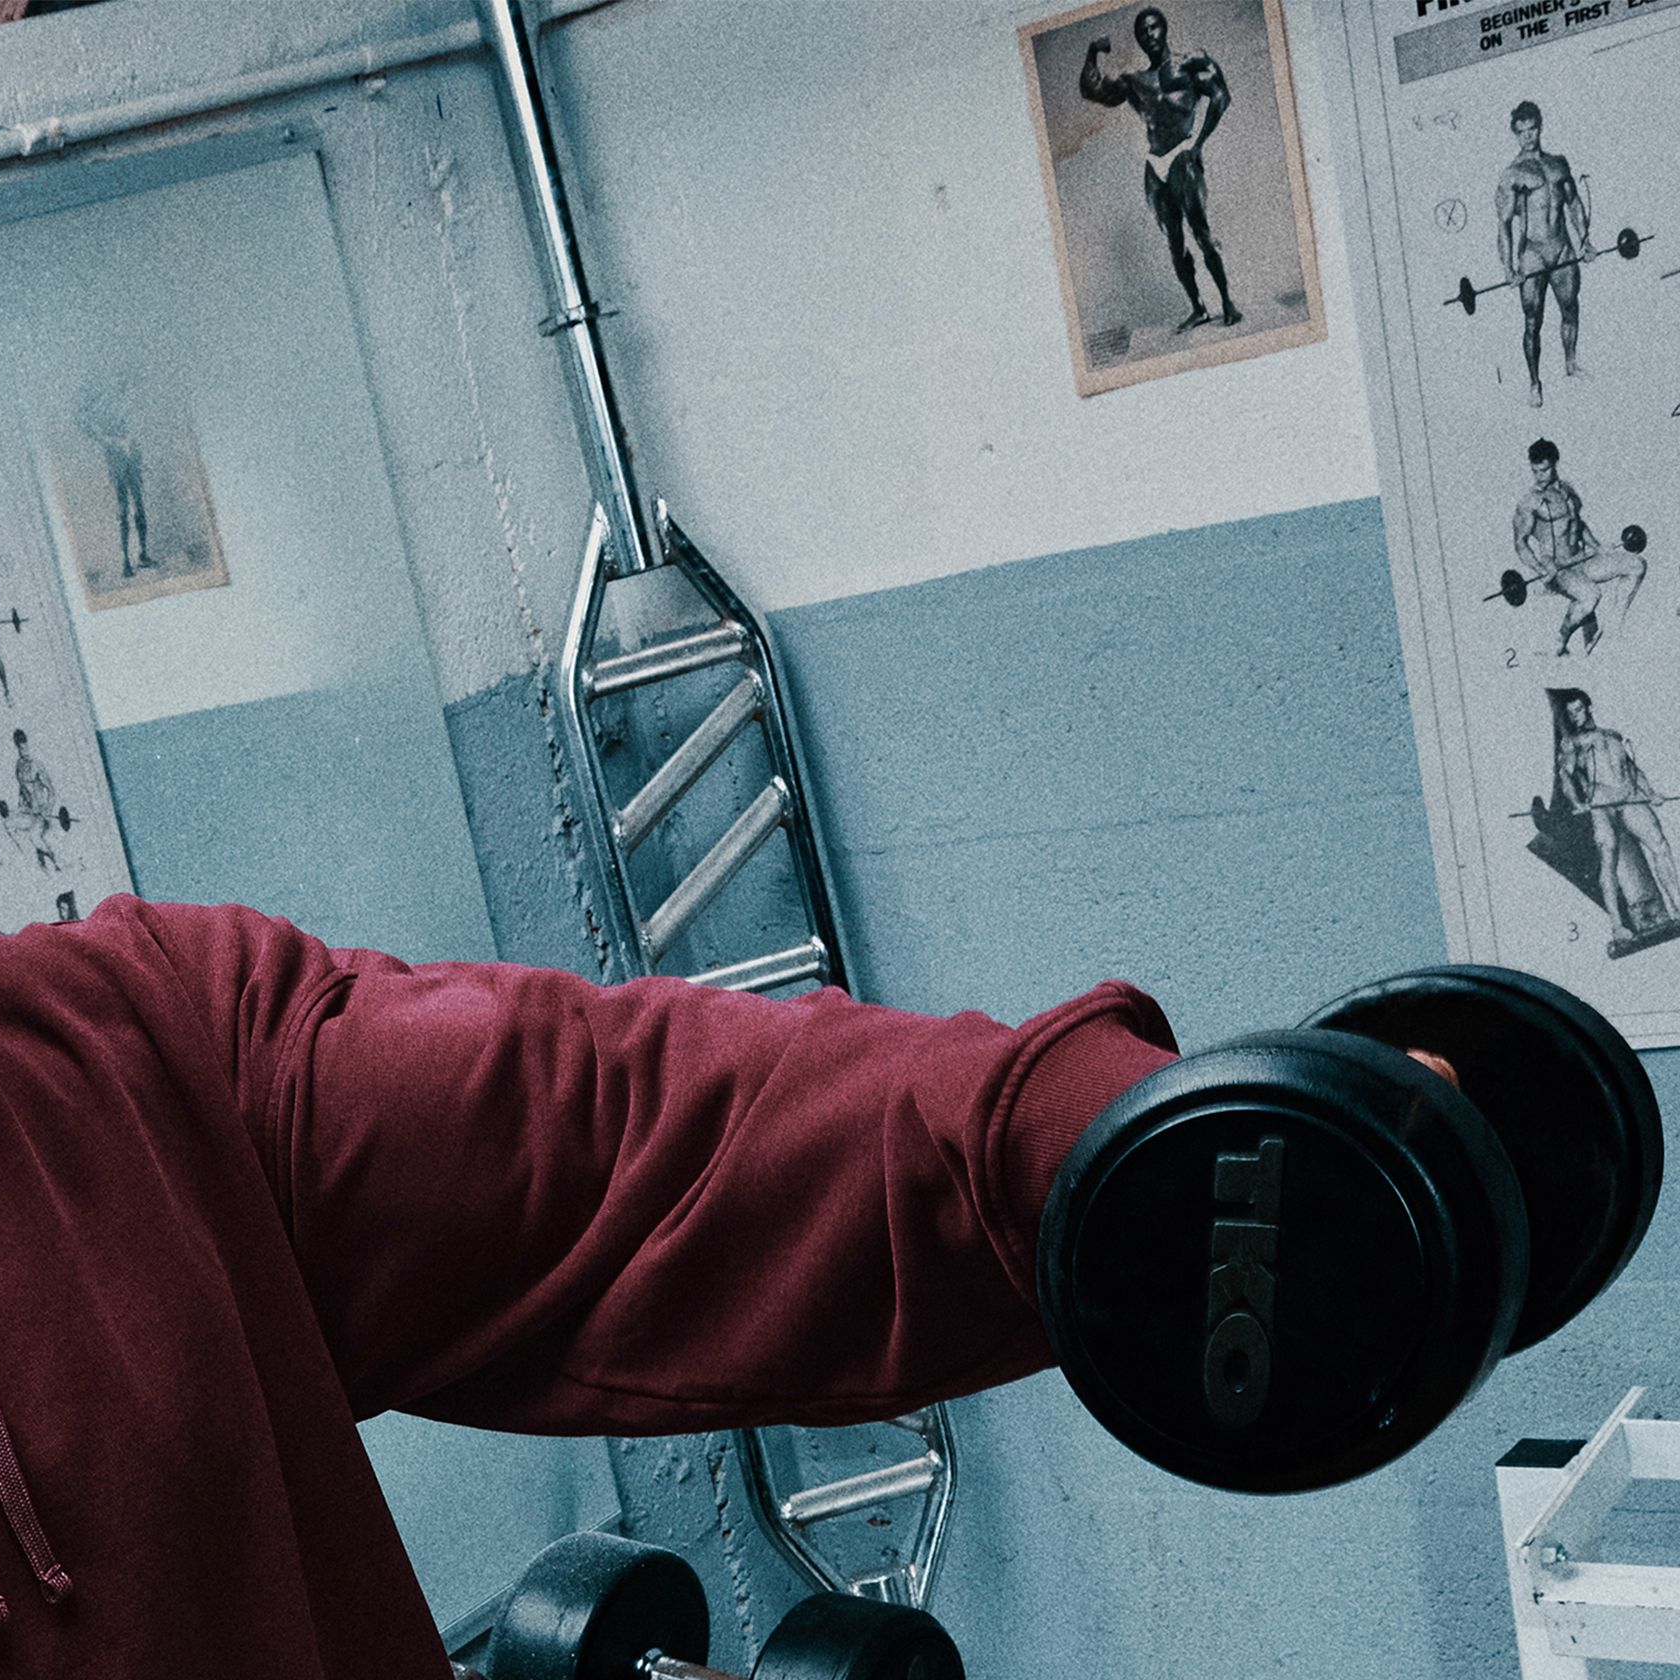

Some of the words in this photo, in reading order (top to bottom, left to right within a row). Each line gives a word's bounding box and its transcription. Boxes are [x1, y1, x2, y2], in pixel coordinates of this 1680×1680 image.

[1479, 32, 1503, 51] ON
[1516, 18, 1551, 40] THE
[1564, 0, 1611, 27] FIRST
[1504, 647, 1519, 668] 2
[1566, 921, 1581, 942] 3
[1203, 1133, 1285, 1428] TKO
